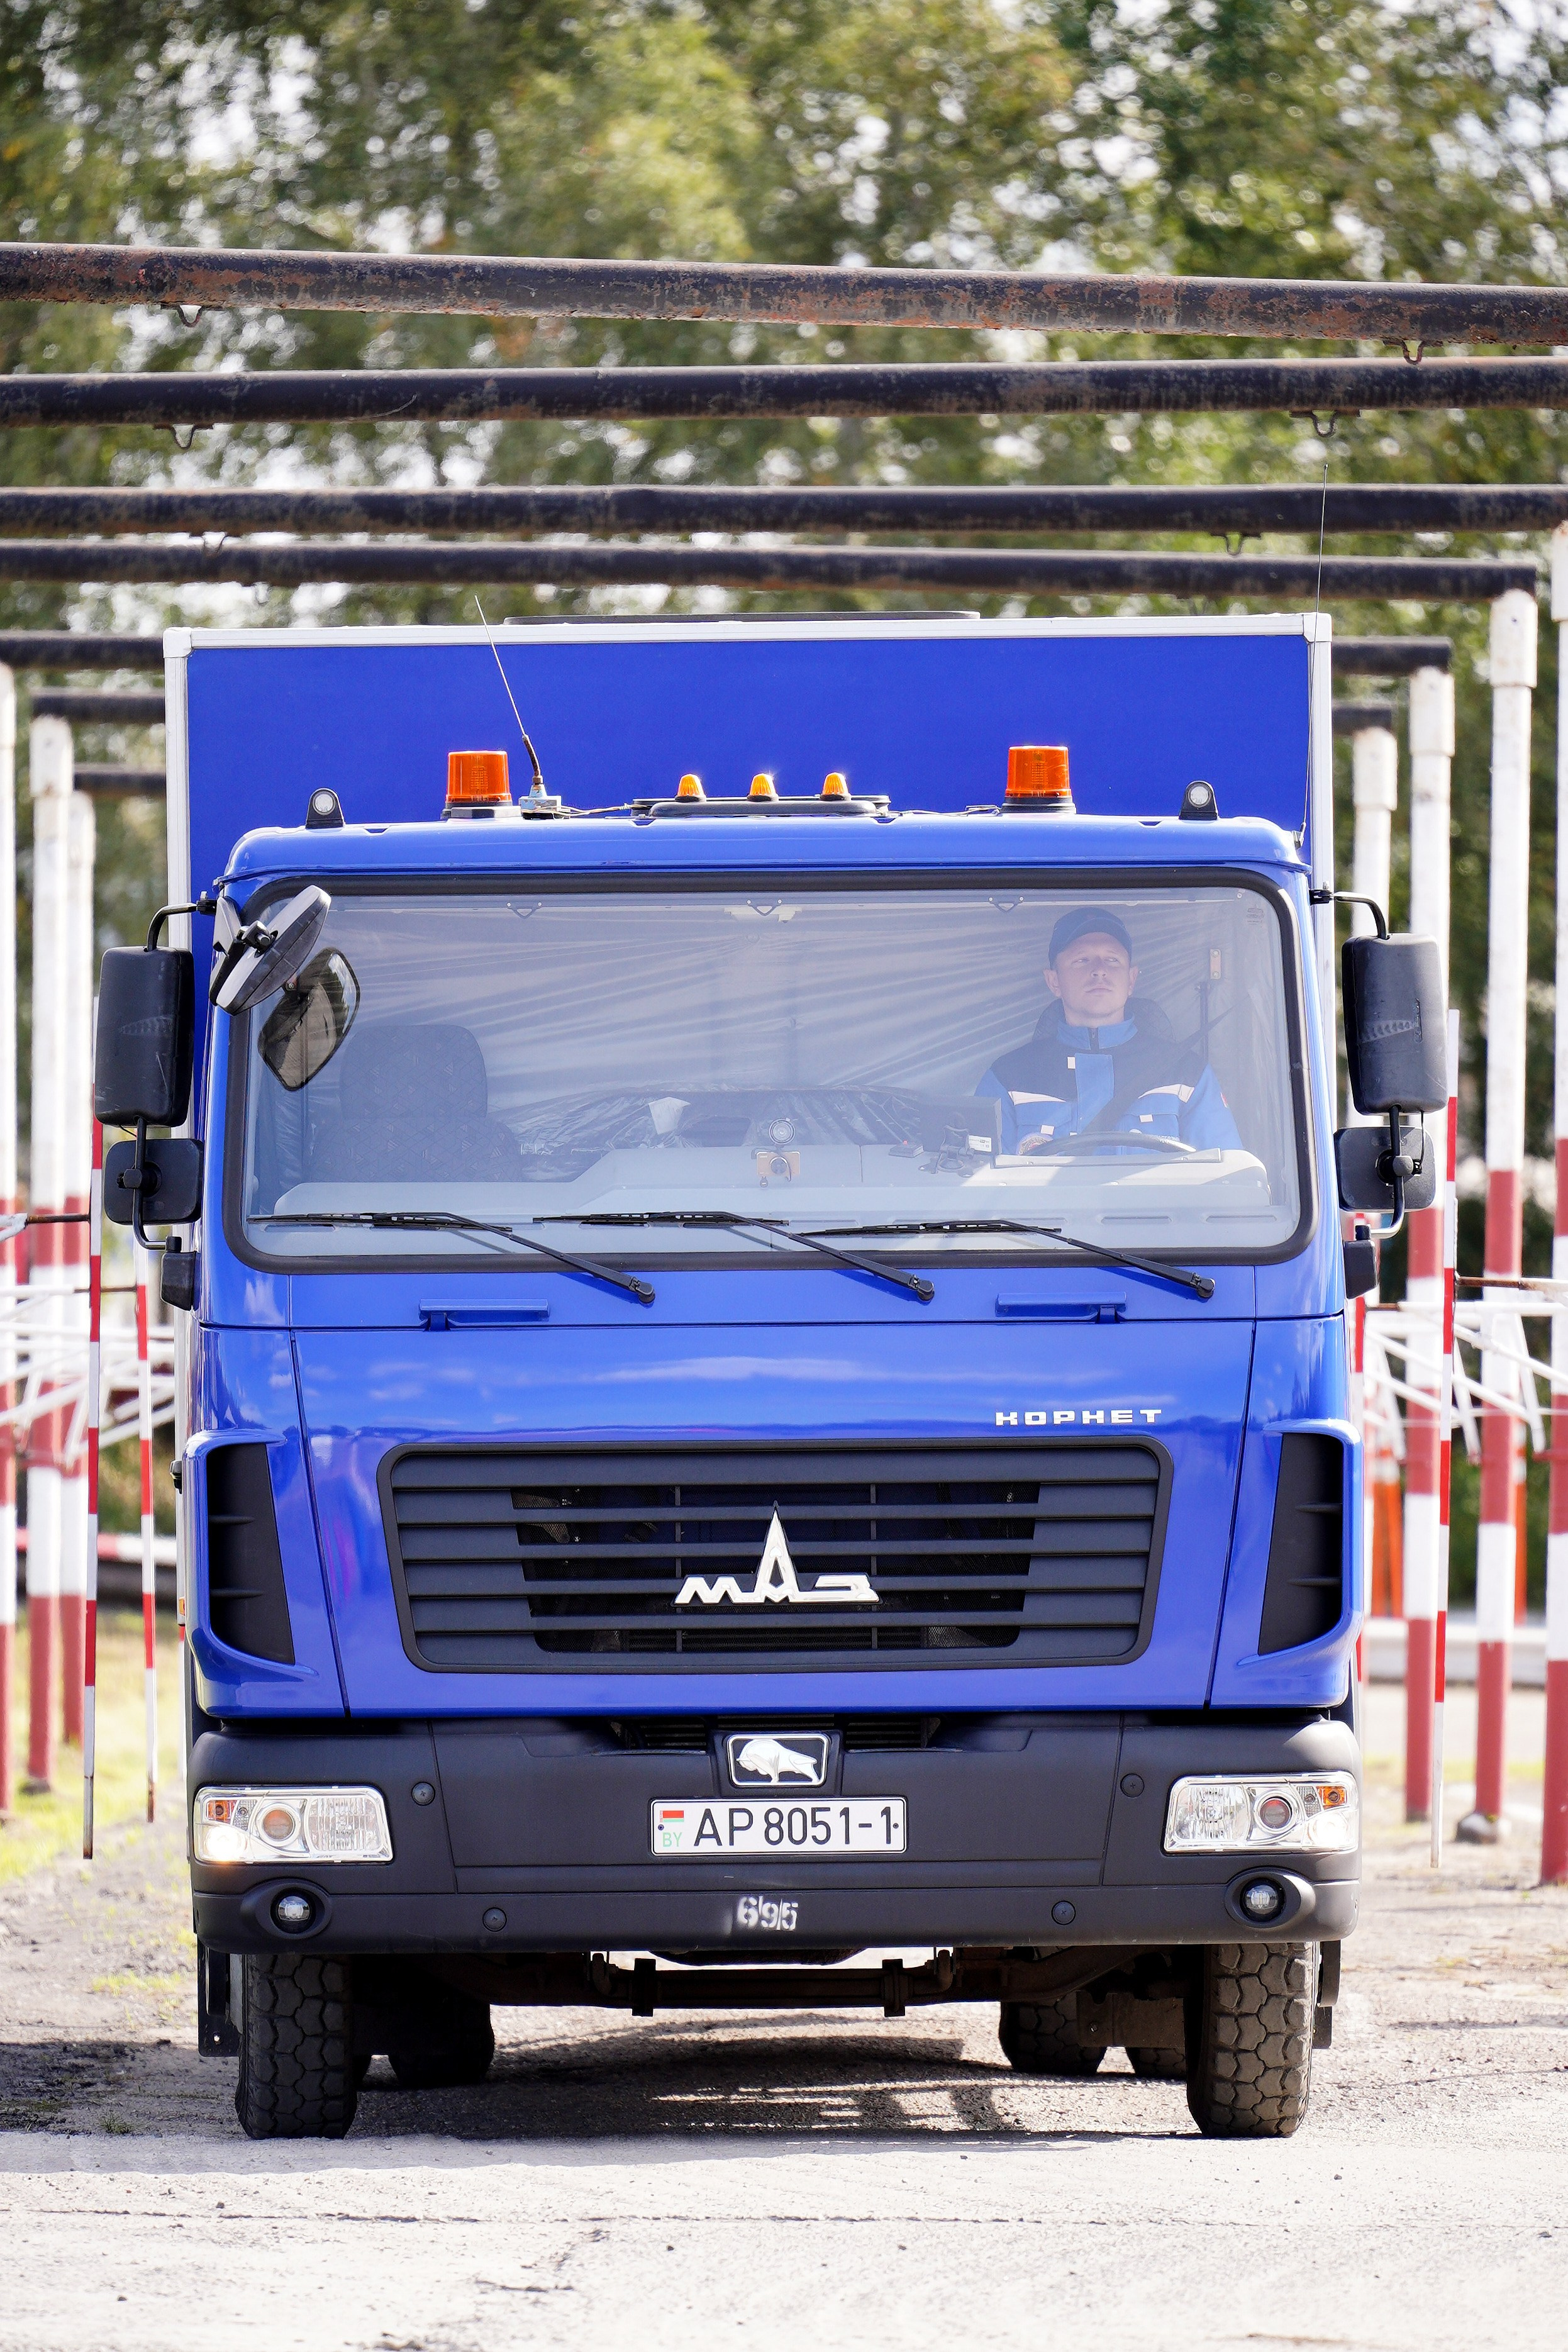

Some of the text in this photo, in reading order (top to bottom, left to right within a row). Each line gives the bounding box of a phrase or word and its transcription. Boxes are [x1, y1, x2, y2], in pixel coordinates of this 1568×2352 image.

[995, 1409, 1162, 1426] КОРНЕТ
[764, 1807, 891, 1845] 8051-1
[663, 1832, 682, 1847] BY
